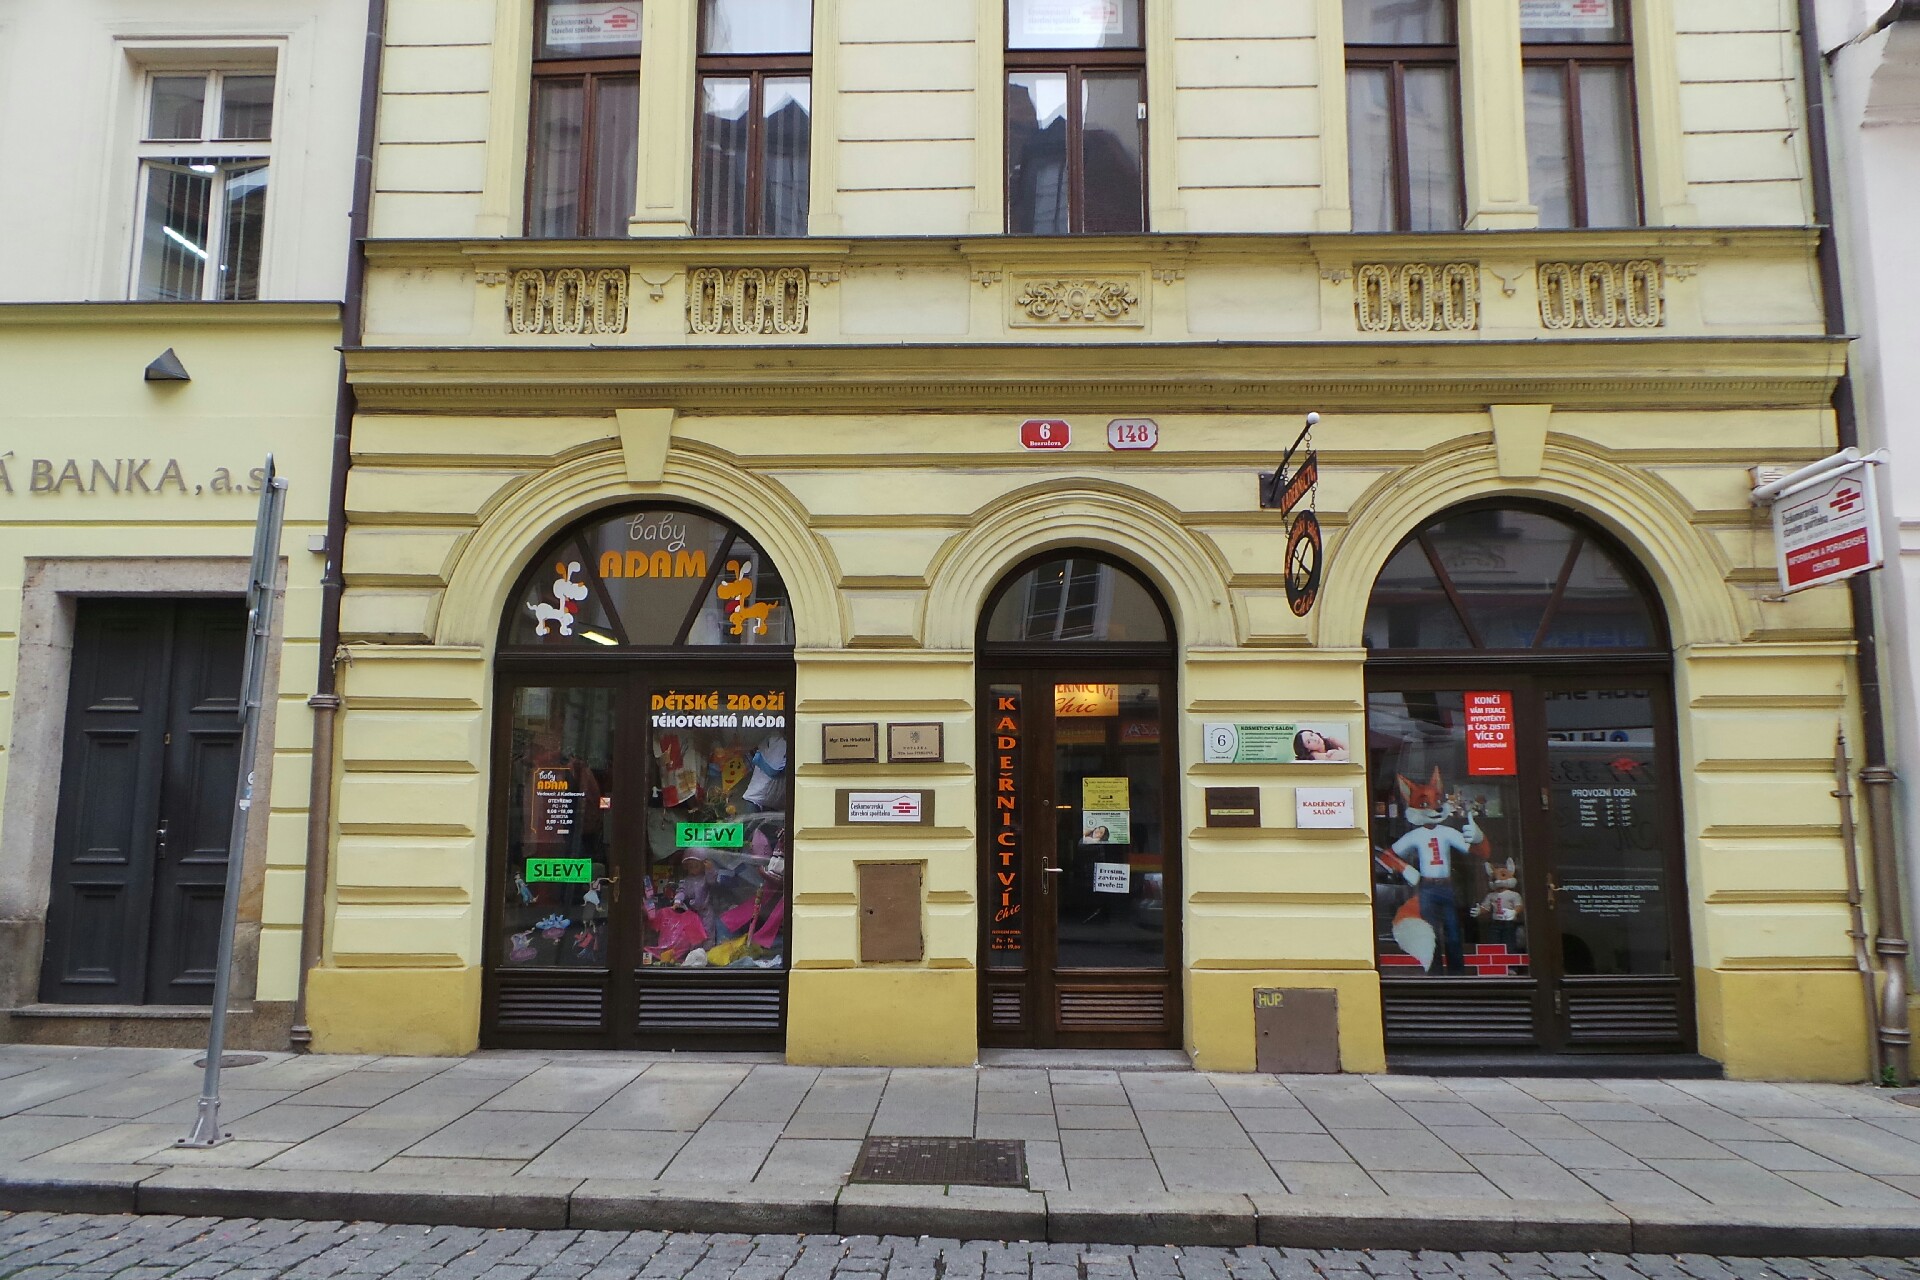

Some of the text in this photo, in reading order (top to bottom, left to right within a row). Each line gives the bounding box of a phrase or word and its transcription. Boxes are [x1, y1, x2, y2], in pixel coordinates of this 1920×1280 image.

[1039, 423, 1051, 440] 6
[1117, 425, 1149, 443] 148
[626, 512, 687, 552] baby
[599, 550, 707, 578] ADAM
[651, 690, 785, 711] DĚTSKÉ ZBOŽÍ
[1474, 694, 1501, 704] KONČÍ
[651, 712, 785, 728] TĚHOTENSKÁ MÓDA
[1217, 734, 1226, 747] 6
[1474, 731, 1504, 740] VÍCE O
[537, 781, 568, 790] ADAM
[1571, 787, 1638, 797] PROVOZNÍ DOBA
[997, 697, 1017, 906] KADEŘNICTVÍ
[684, 828, 736, 841] SLEVY
[533, 864, 585, 877] SLEVY
[995, 904, 1021, 922] Chic
[1258, 992, 1283, 1006] HUP
